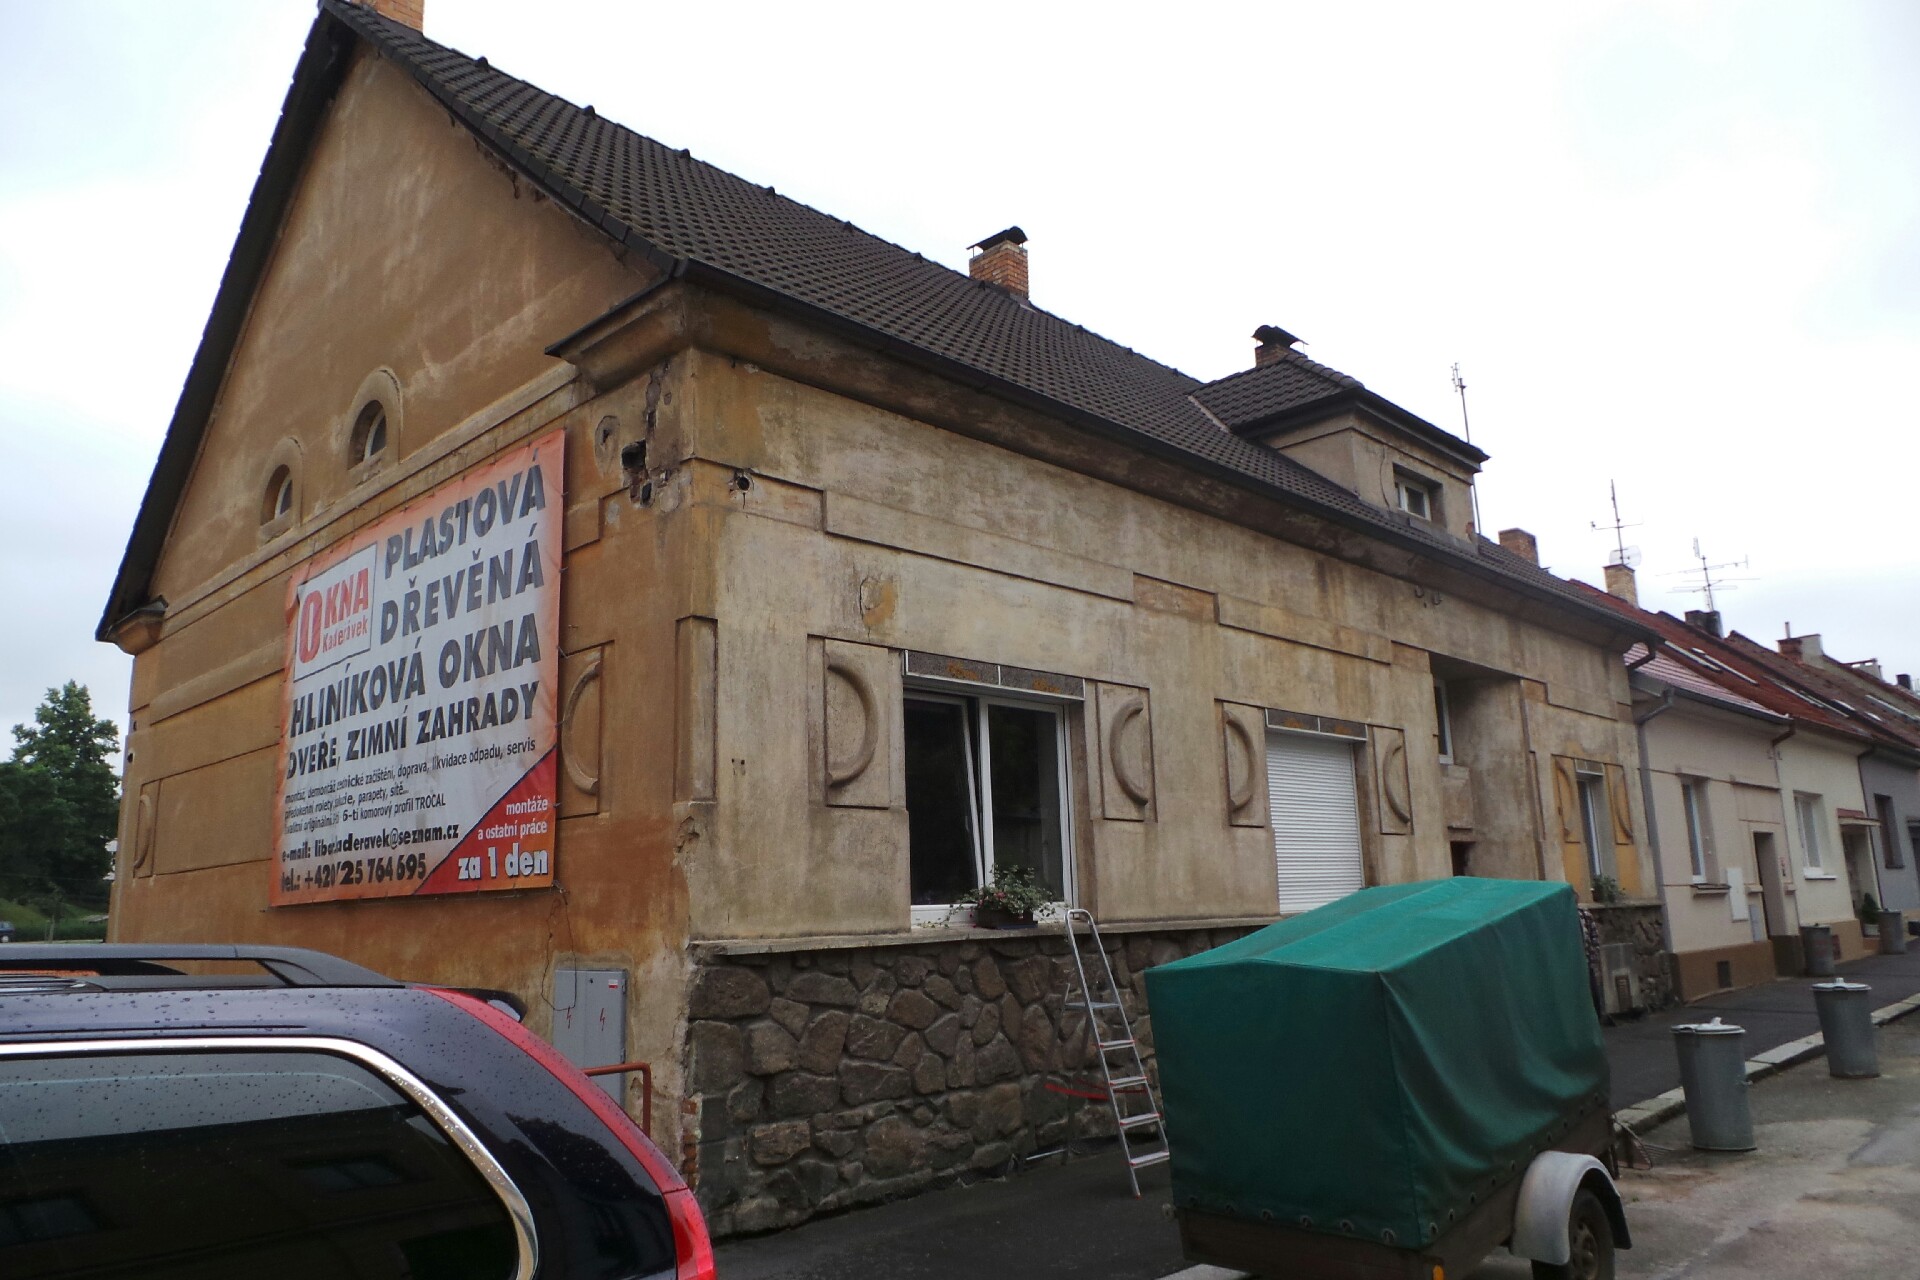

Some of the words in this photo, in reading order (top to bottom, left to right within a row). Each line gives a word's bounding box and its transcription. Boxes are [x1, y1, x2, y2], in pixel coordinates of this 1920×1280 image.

[384, 448, 545, 580] PLASTOVÁ
[380, 522, 544, 646] DŘEVĚNÁ
[299, 568, 368, 663] OKNA
[290, 636, 426, 738] HLINÍKOVÁ
[439, 612, 541, 688] OKNA
[286, 732, 341, 779] DVEŘE,
[346, 705, 408, 761] ZIMNÍ
[416, 681, 539, 745] ZAHRADY
[398, 761, 430, 780] doprava,
[432, 750, 467, 771] likvidace
[469, 743, 503, 766] odpadu,
[507, 738, 535, 756] servis
[343, 808, 359, 822] 6-ti
[361, 801, 392, 819] komorový
[394, 798, 413, 817] profil
[415, 793, 446, 812] TROCAL
[506, 795, 549, 815] montáže
[478, 829, 484, 840] a
[486, 820, 518, 839] ostatní
[520, 818, 548, 839] práce
[282, 840, 311, 862] e-mail:
[367, 857, 393, 883] 764
[396, 853, 426, 880] 695
[458, 857, 481, 880] za
[488, 847, 498, 878] 1
[505, 842, 549, 877] den
